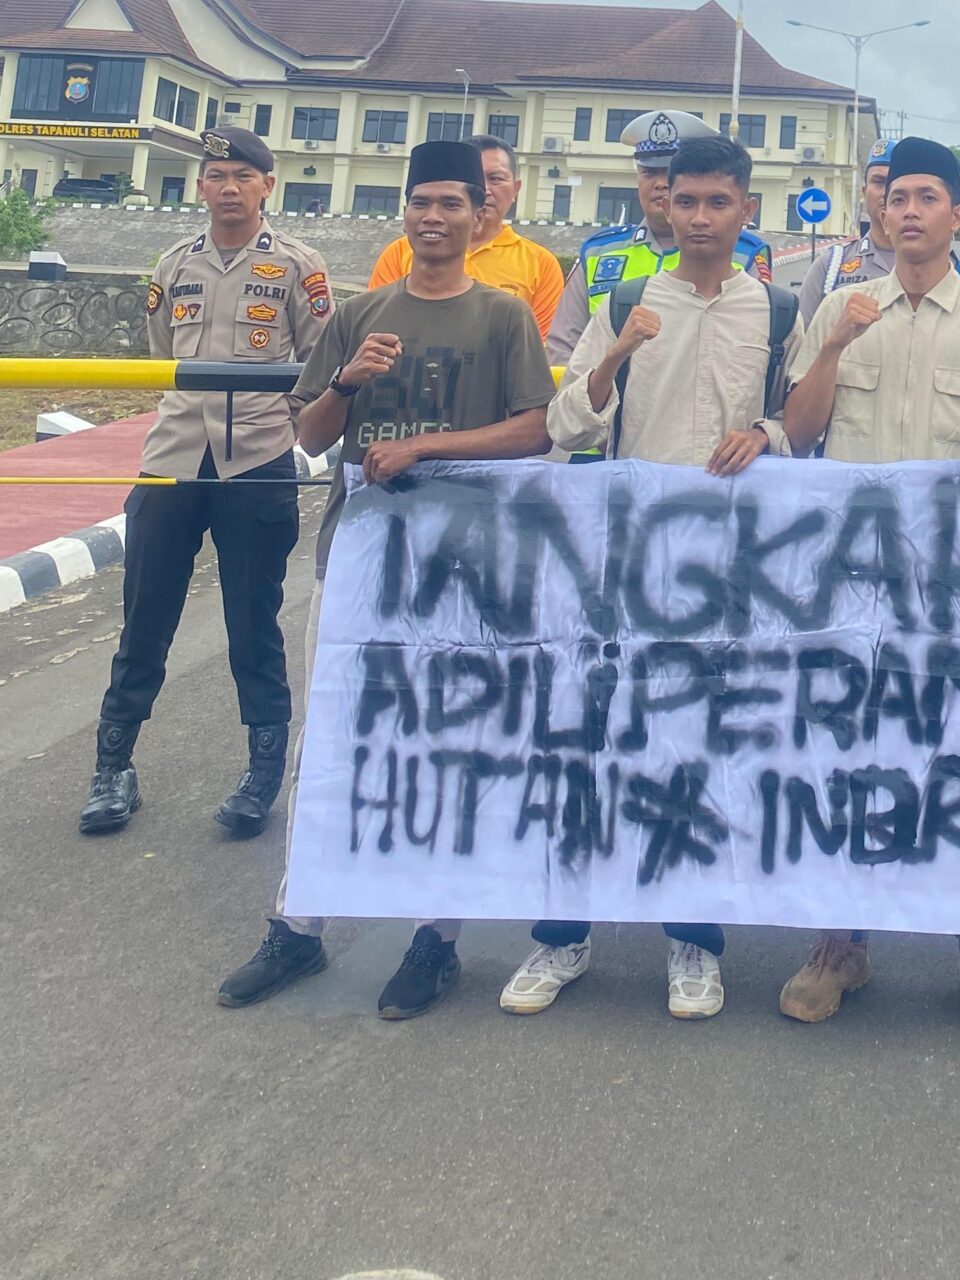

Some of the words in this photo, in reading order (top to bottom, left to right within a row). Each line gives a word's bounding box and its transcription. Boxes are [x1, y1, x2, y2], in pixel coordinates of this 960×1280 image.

[36, 125, 89, 137] TAPANULI
[91, 127, 140, 139] SELATAN
[244, 283, 286, 300] POLRI
[353, 640, 620, 754] ADILI
